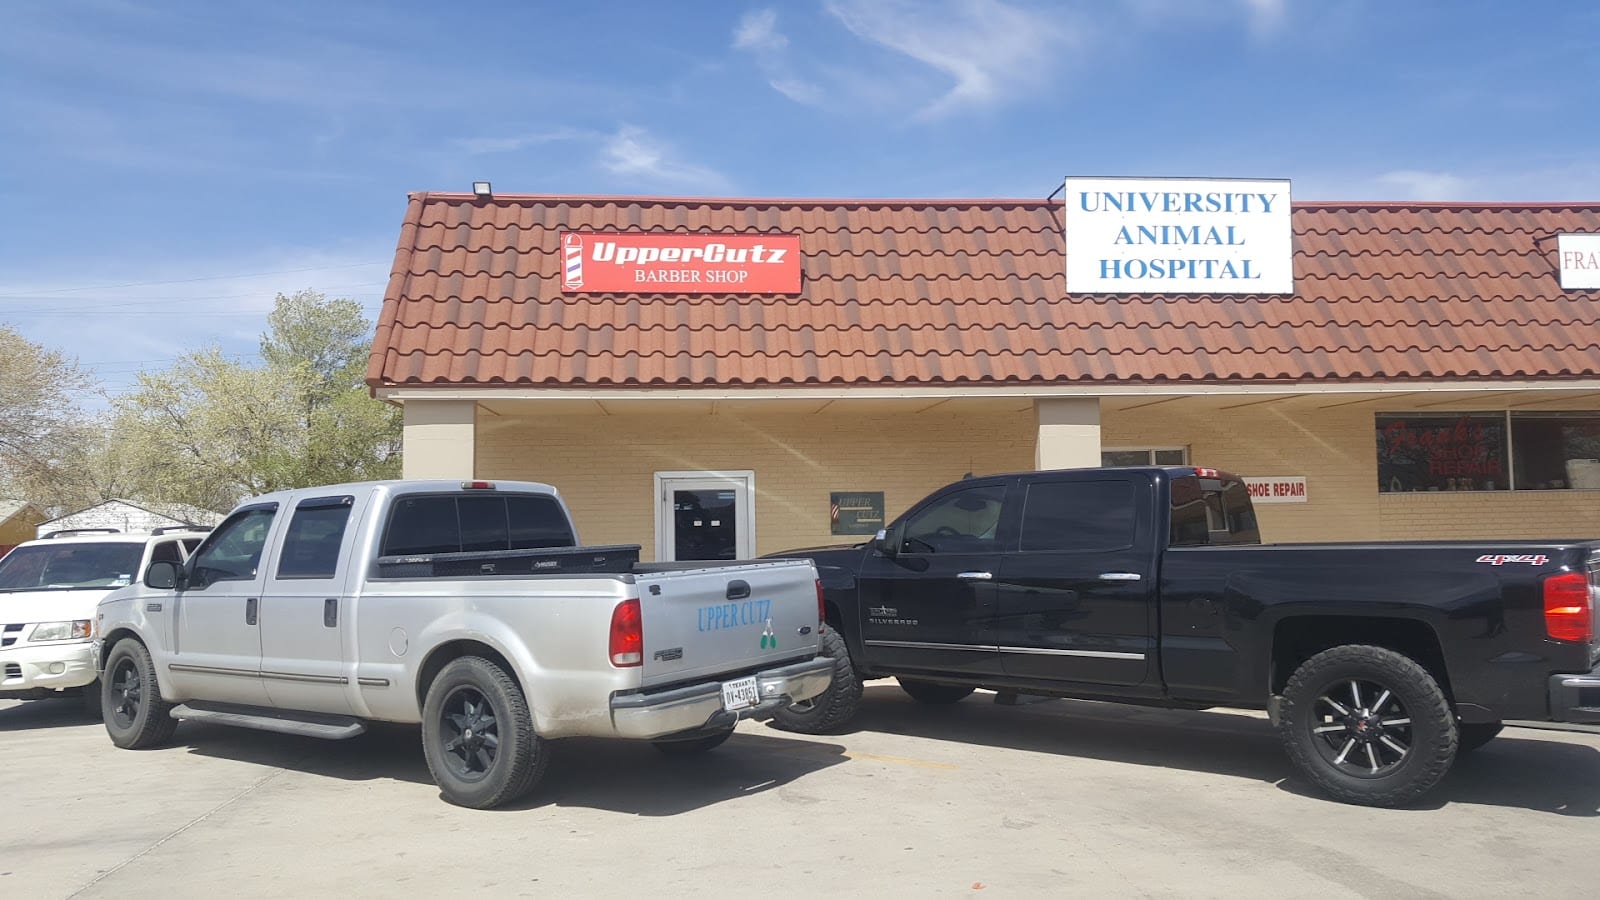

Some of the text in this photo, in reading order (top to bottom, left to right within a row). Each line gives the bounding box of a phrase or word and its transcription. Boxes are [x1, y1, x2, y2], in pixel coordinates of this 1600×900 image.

[1079, 191, 1278, 214] UNIVERSITY
[1114, 225, 1246, 246] ANIMAL
[1099, 258, 1262, 280] HOSPITAL
[1562, 251, 1600, 270] FRA
[634, 269, 748, 284] BARBER SHOP
[1247, 482, 1305, 497] SHOE REPAIR
[698, 599, 771, 632] UPPER CUTZ
